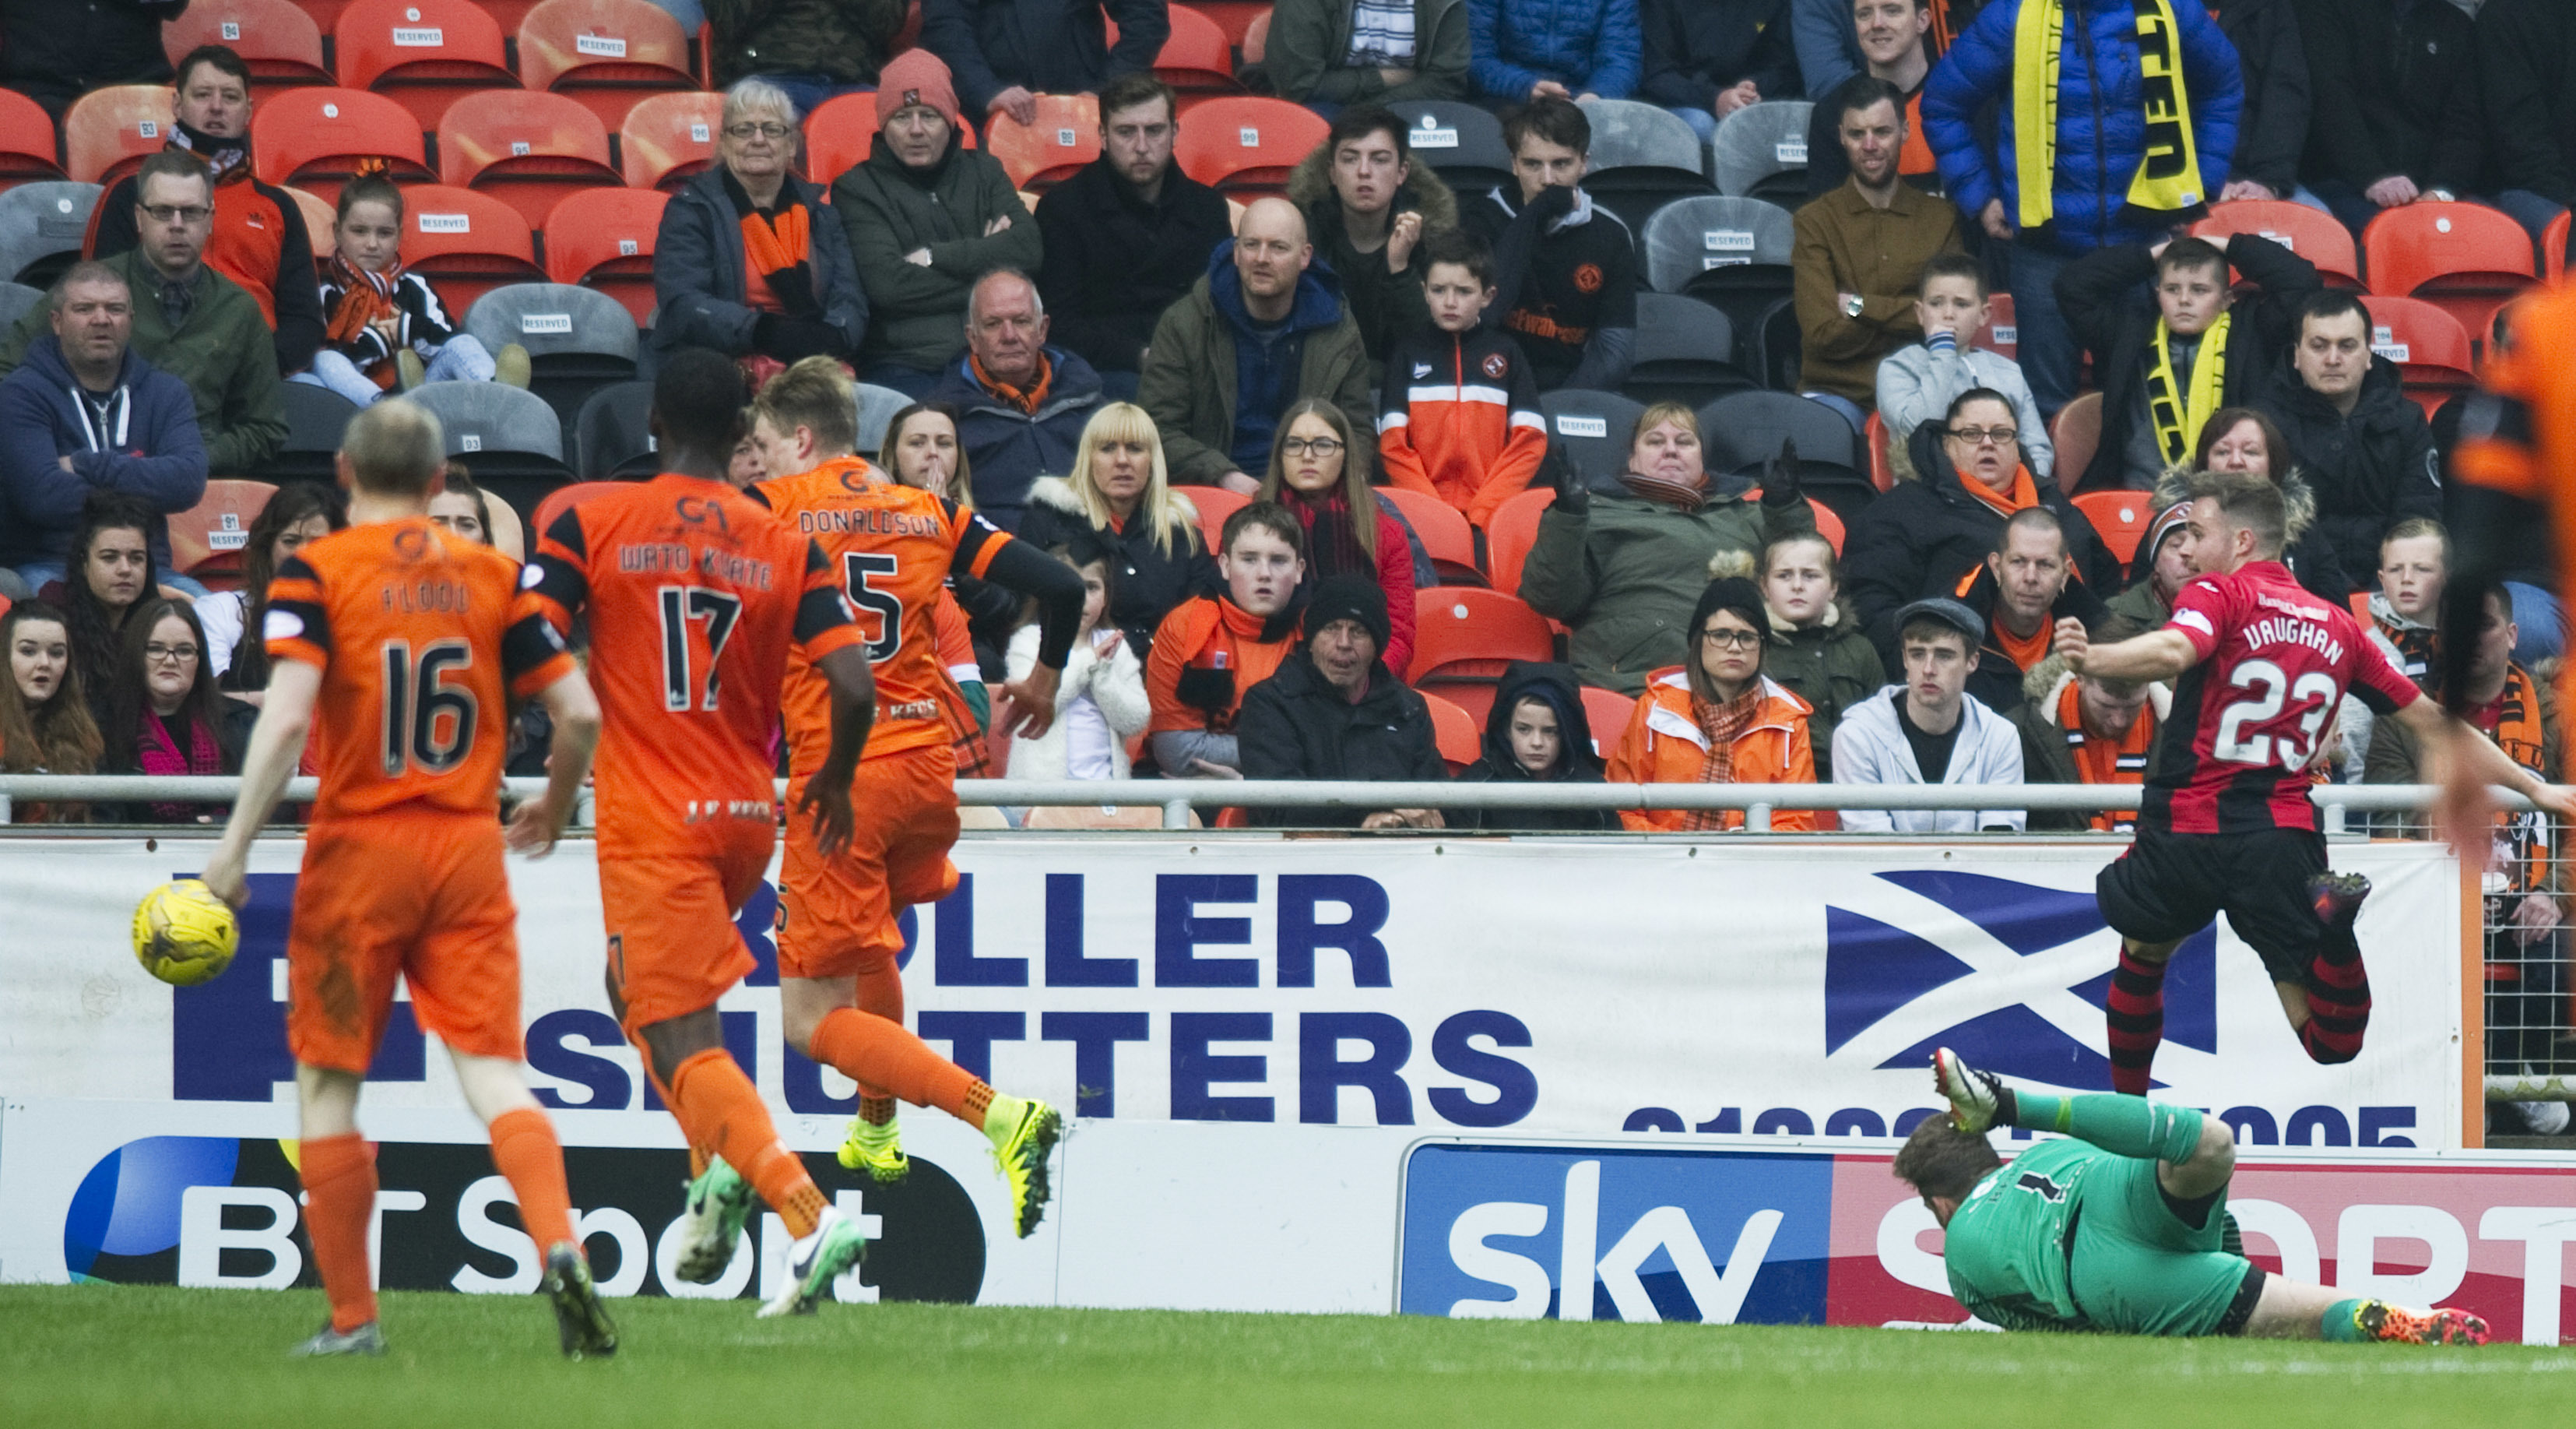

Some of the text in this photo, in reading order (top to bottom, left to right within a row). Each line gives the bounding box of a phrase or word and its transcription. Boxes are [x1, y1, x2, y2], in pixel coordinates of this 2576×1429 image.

[396, 31, 441, 42] RESERVED
[580, 40, 624, 52] RESERVED
[694, 128, 708, 139] 96
[1411, 133, 1456, 145] RESERVED
[422, 218, 466, 230] RESERVED
[1709, 234, 1751, 245] RESERVED
[623, 243, 636, 254] 95
[525, 318, 568, 329] RESERVED
[1561, 421, 1604, 433] RESERVED
[844, 551, 903, 663] 5
[2243, 618, 2344, 666] VAUGHAN
[659, 586, 742, 712] 17
[381, 638, 479, 777] 16
[2213, 658, 2337, 772] 23
[728, 873, 1393, 988] LLER
